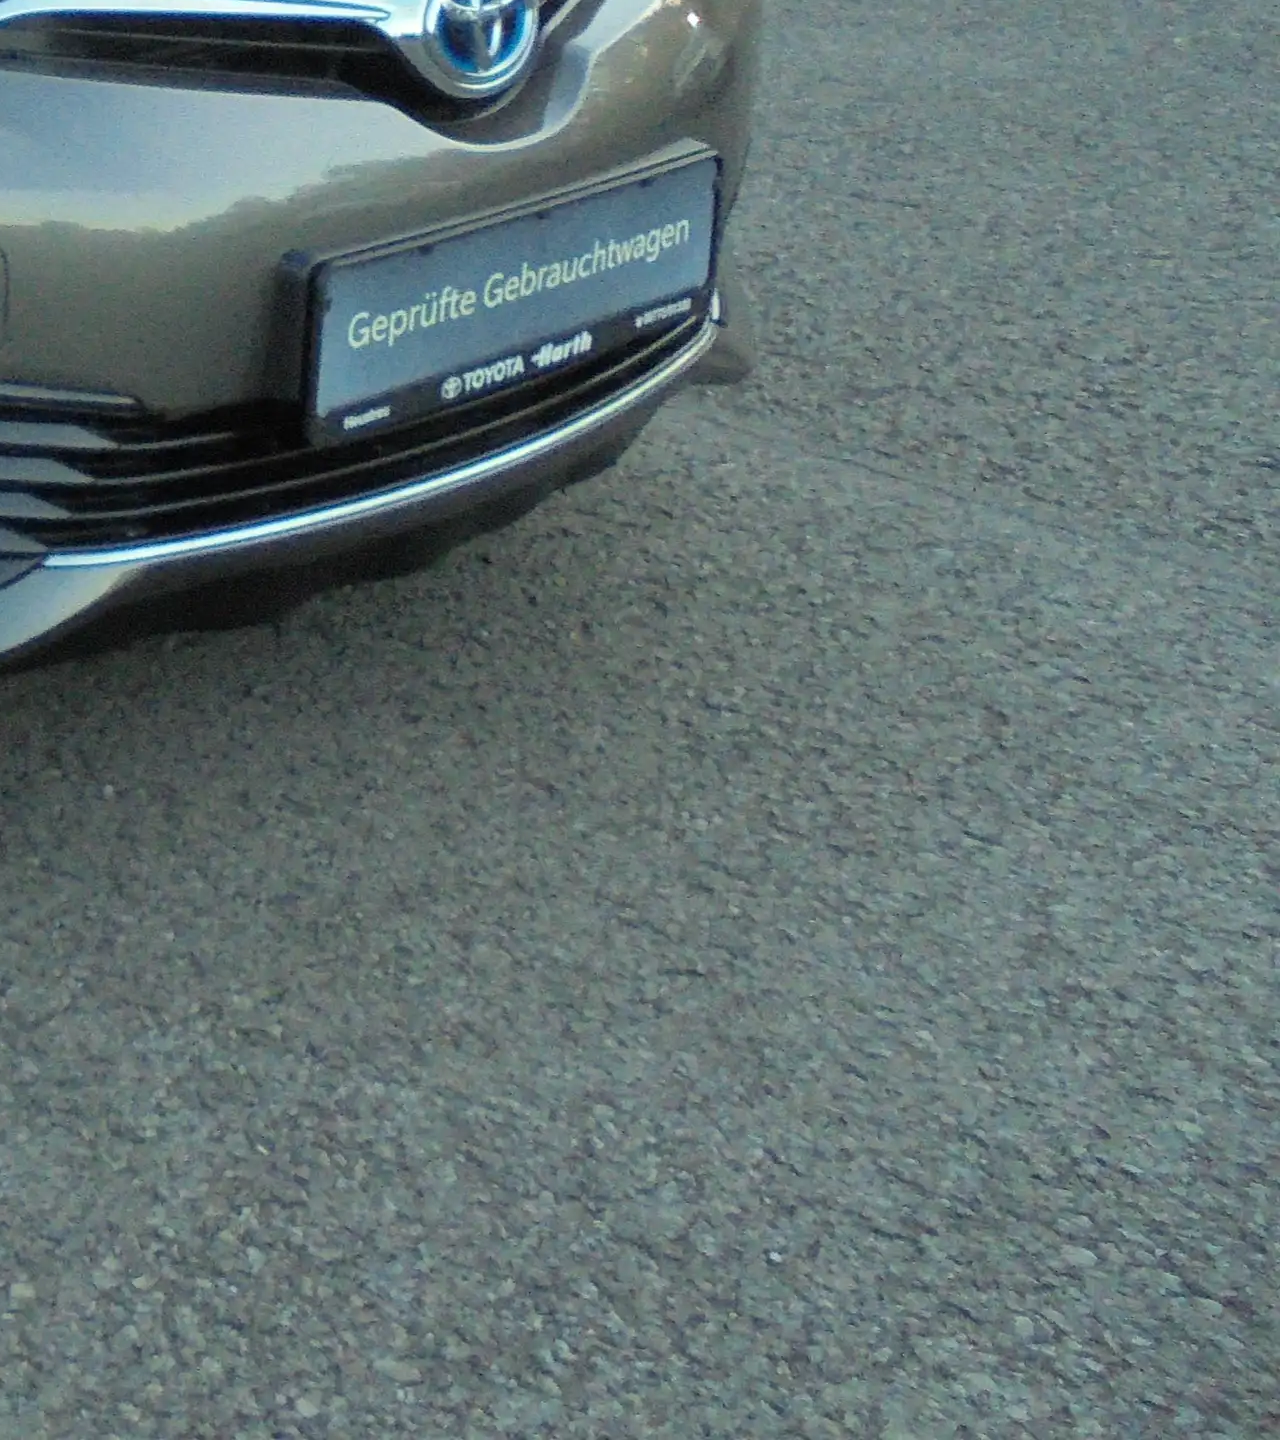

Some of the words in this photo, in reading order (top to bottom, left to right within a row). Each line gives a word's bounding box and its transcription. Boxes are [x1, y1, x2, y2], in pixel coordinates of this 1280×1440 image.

[348, 287, 476, 349] Geprüfte
[483, 218, 690, 308] Gebrauchtwagen
[463, 355, 525, 393] TOYOTA
